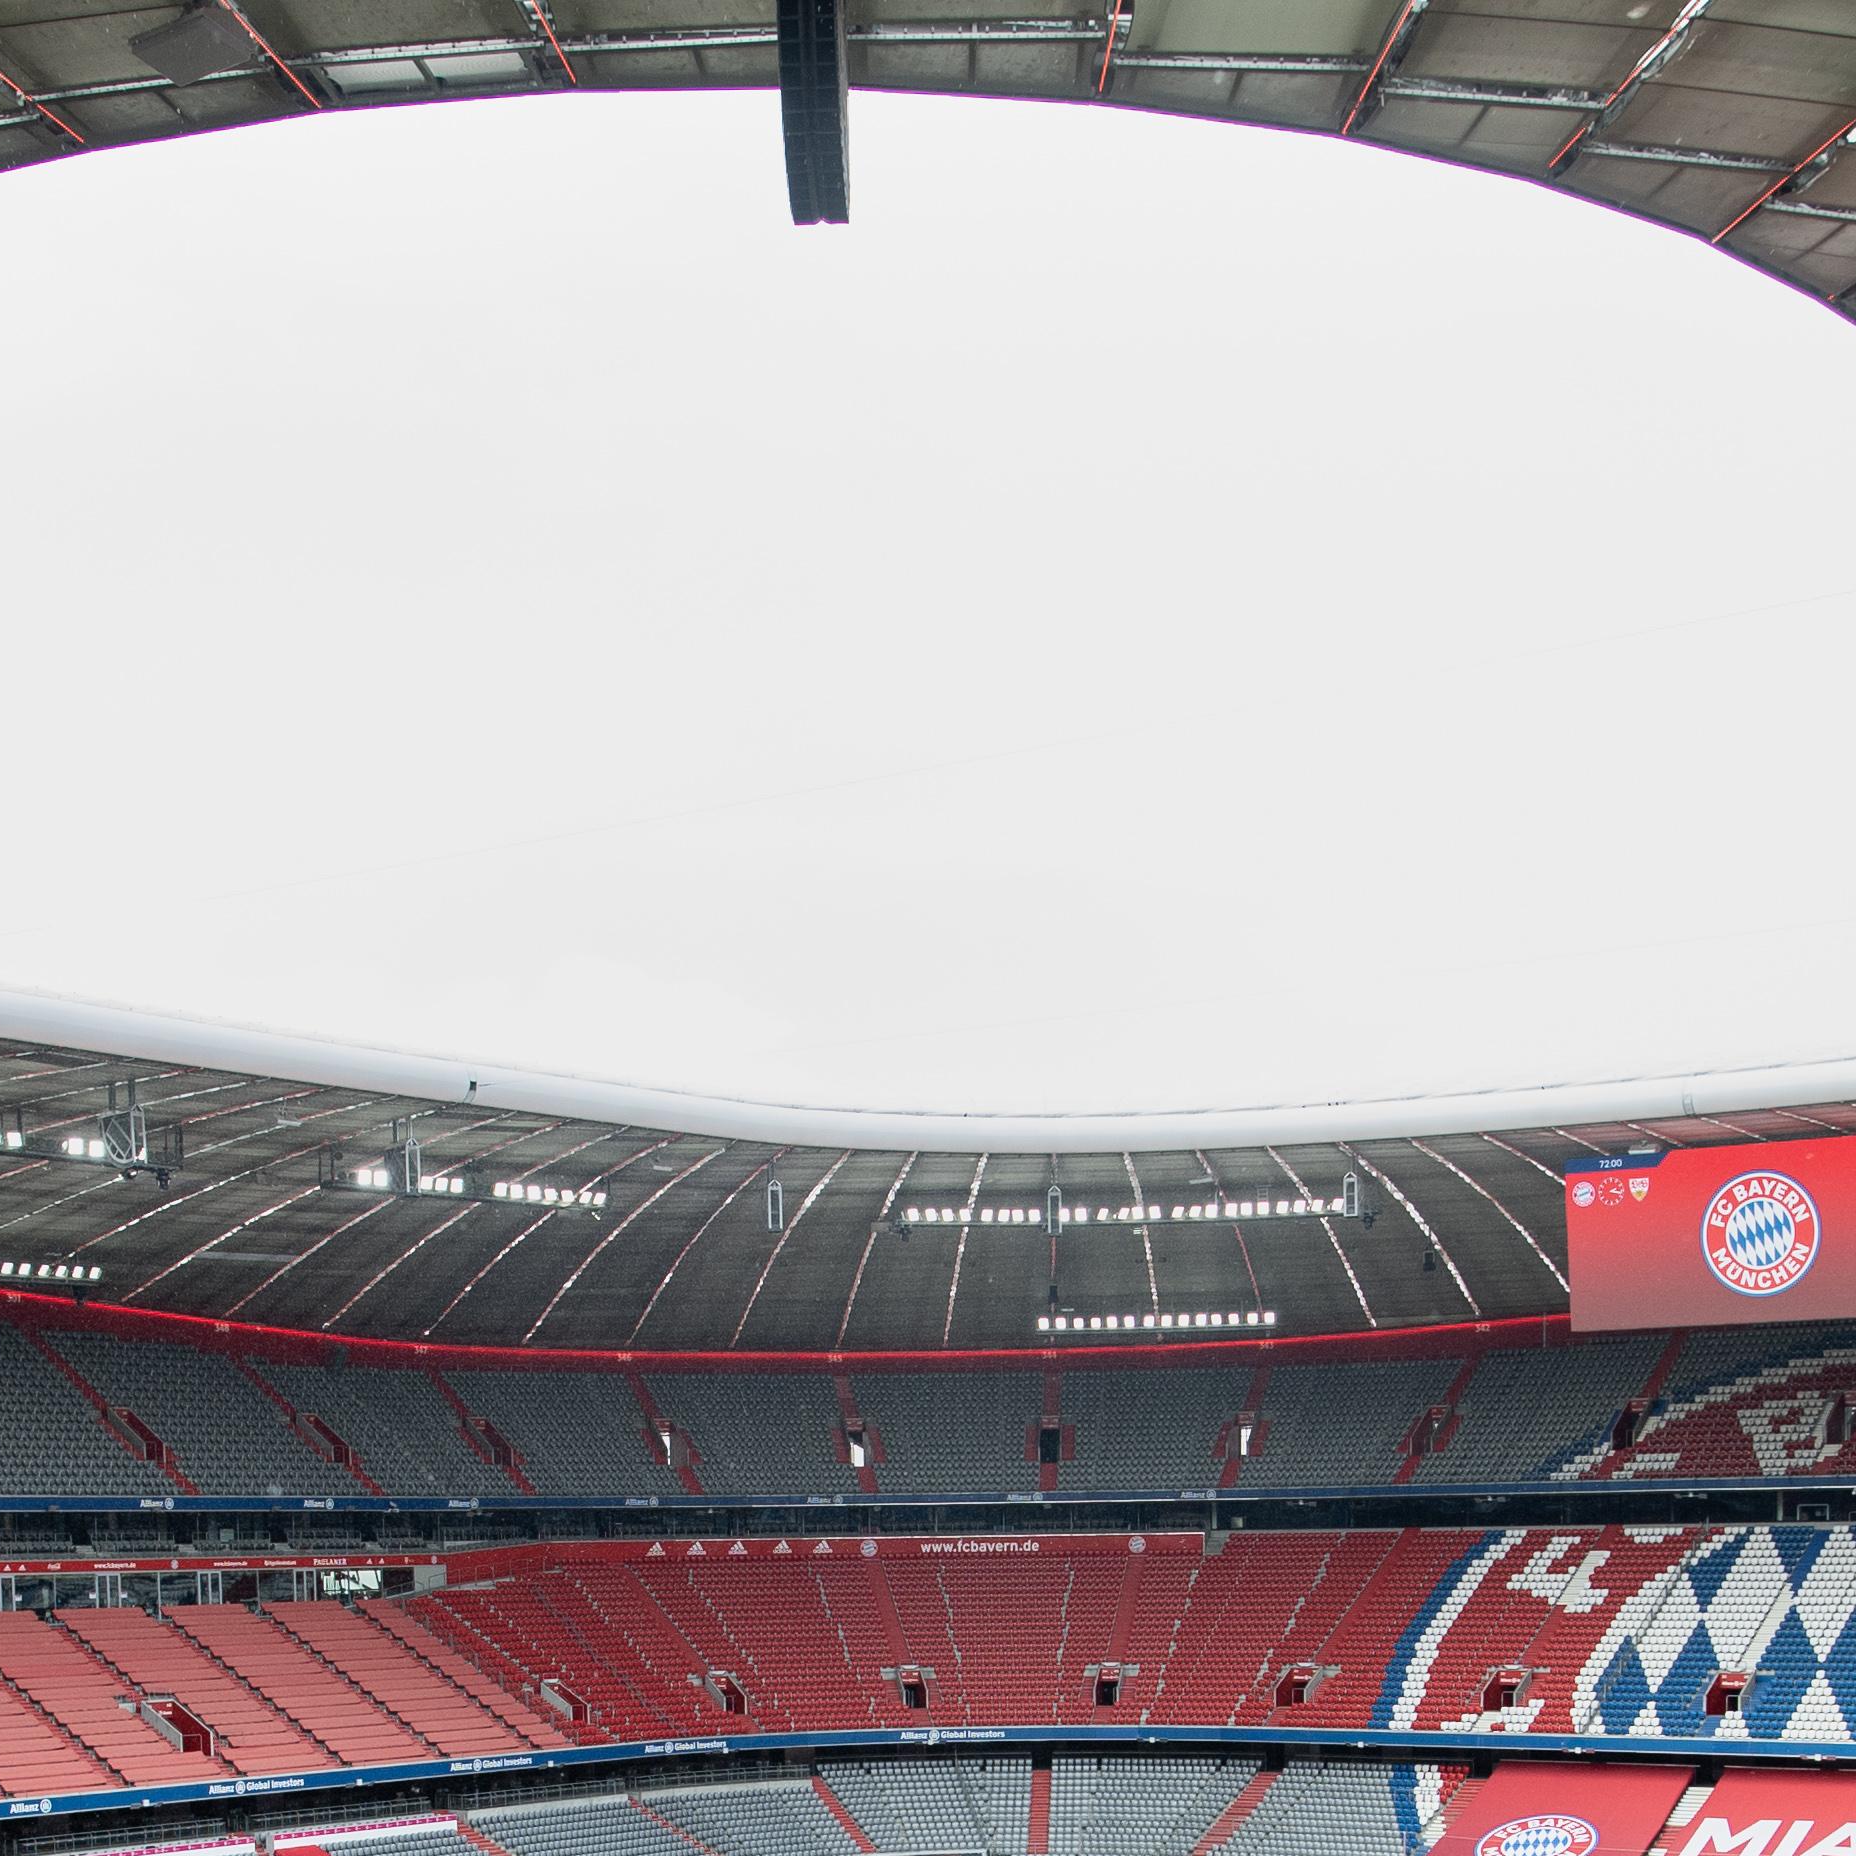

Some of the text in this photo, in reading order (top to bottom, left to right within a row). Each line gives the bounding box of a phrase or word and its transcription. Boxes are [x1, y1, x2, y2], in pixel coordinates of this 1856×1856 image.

[1711, 1178, 1810, 1228] FC BAYERN
[1711, 1242, 1811, 1288] MÜNCHEN
[900, 1729, 1006, 1741] Allianz Global Investors
[674, 1741, 697, 1751] Global
[698, 1739, 727, 1749] Investors
[482, 1758, 504, 1769] Global
[505, 1756, 533, 1766] Investors
[208, 1777, 305, 1794] Allianz Global Investors
[9, 1800, 40, 1815] Allianz
[1494, 1818, 1591, 1843] FC BAYERN
